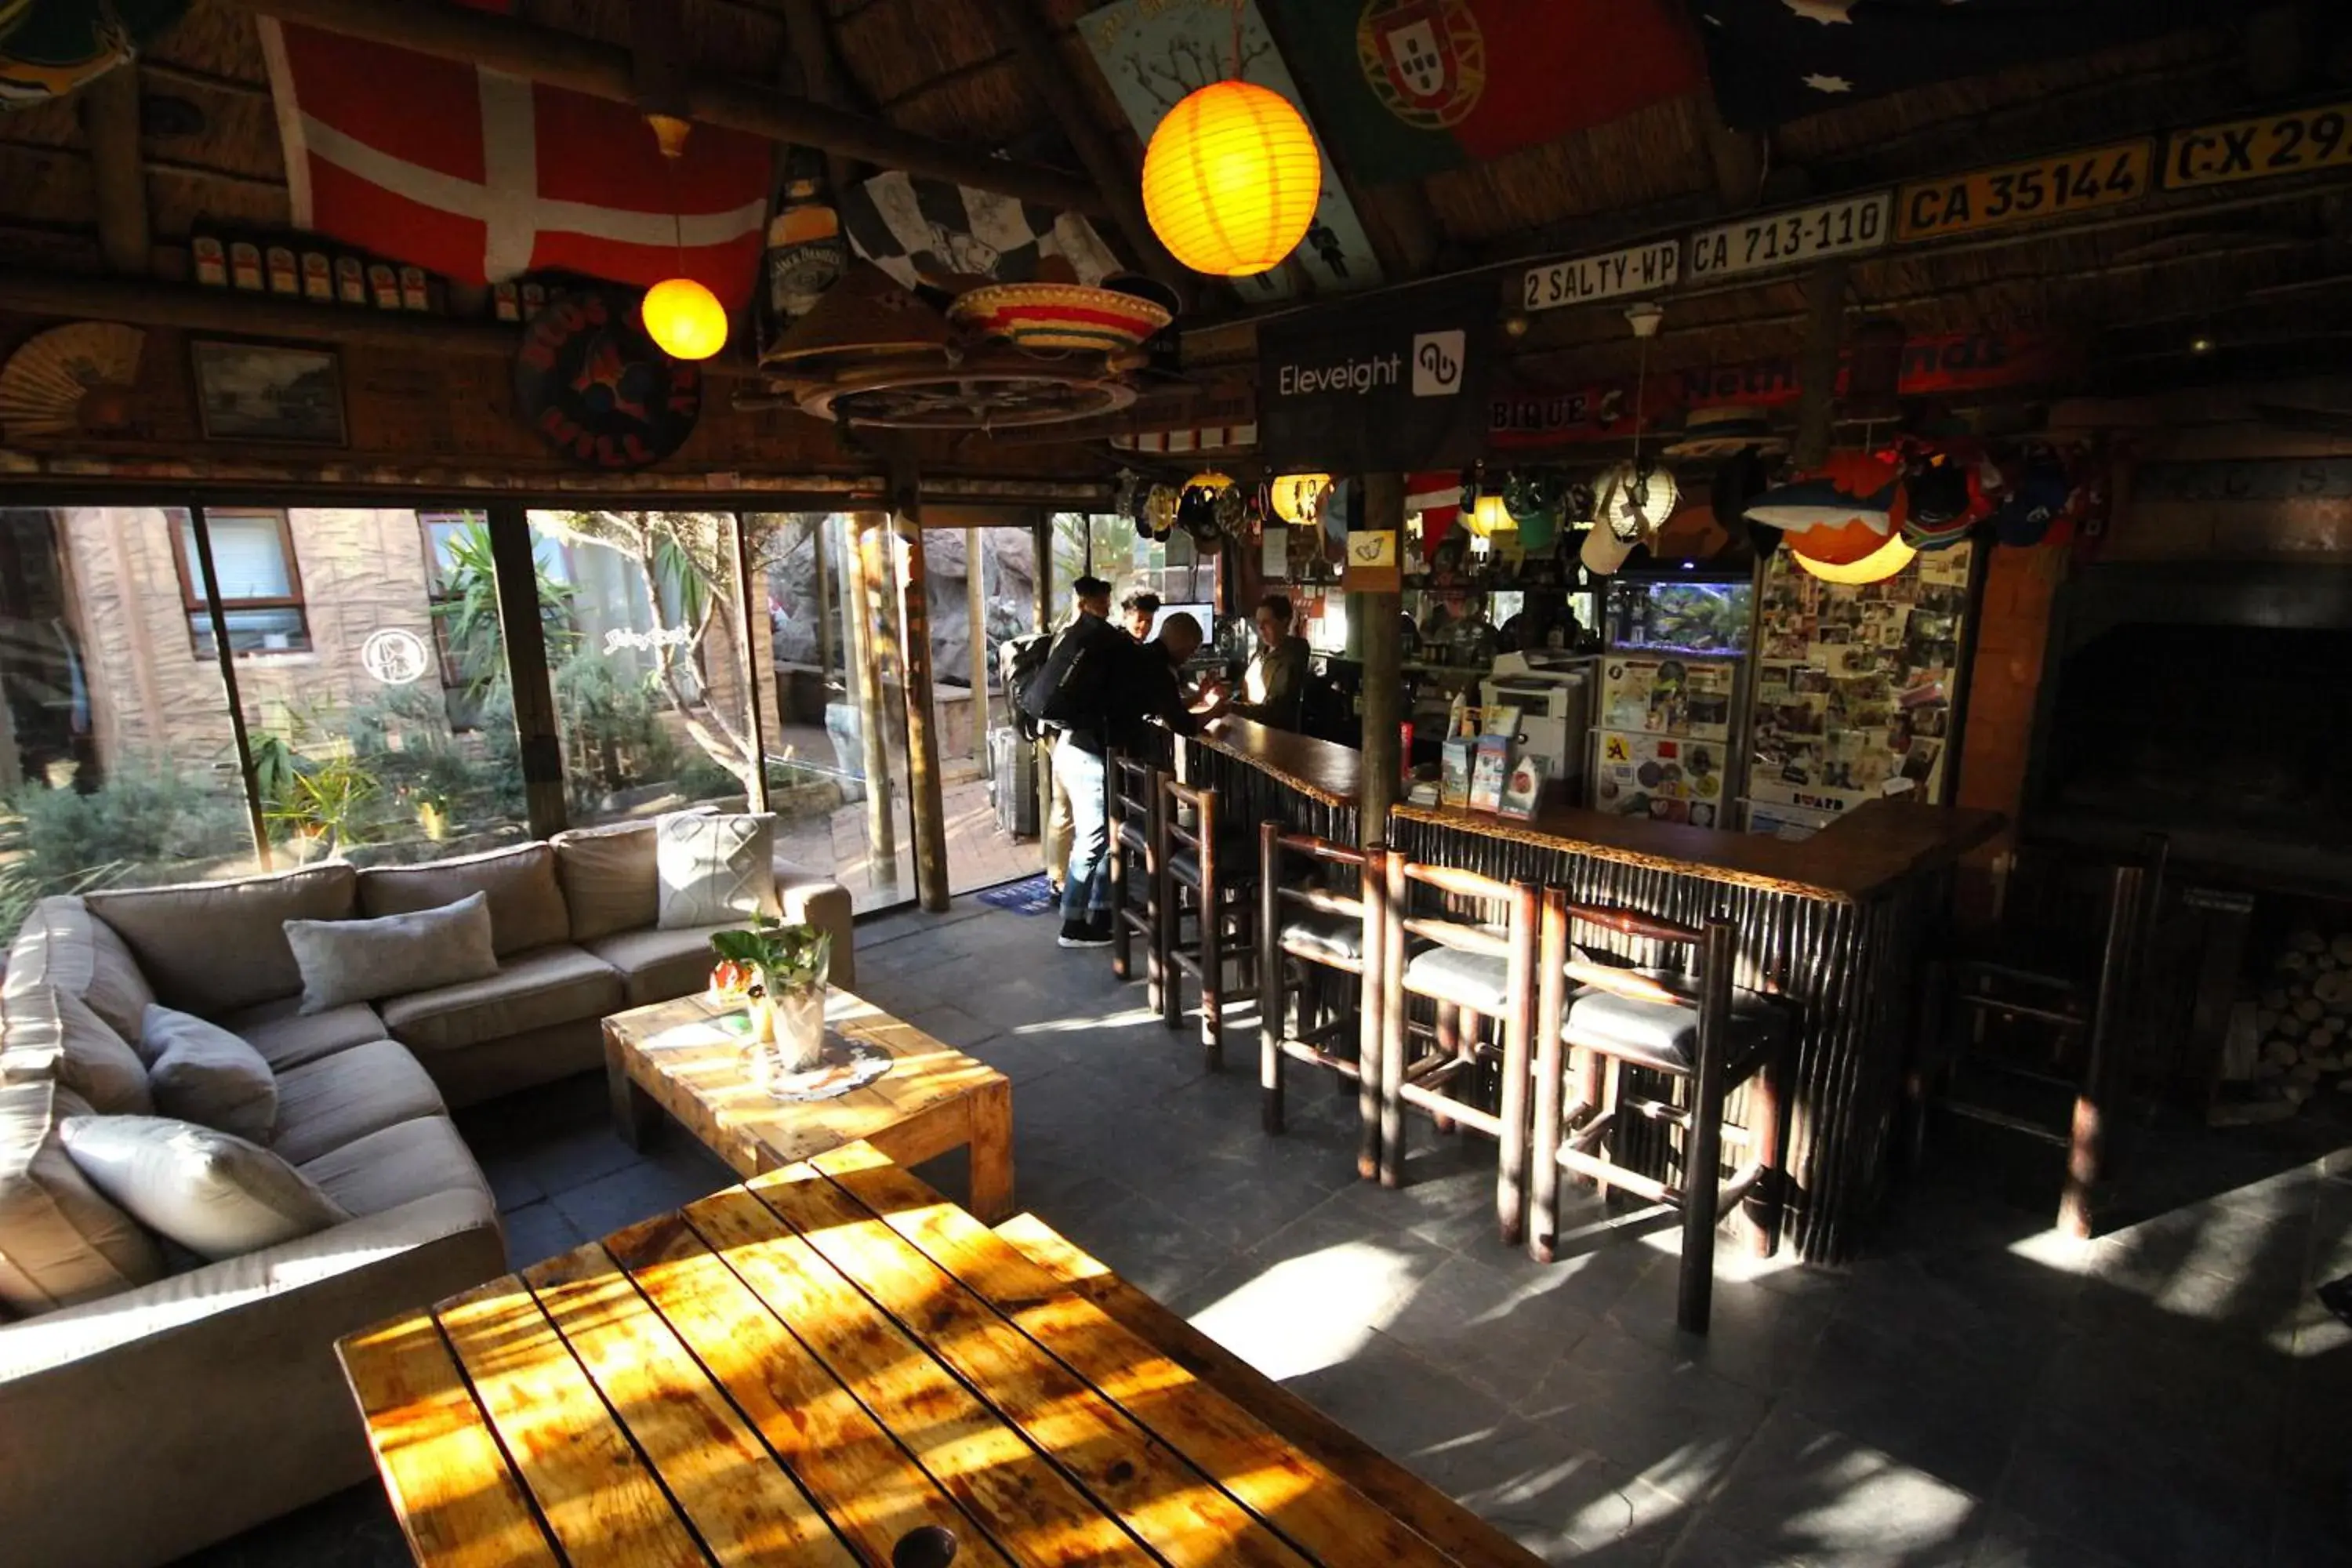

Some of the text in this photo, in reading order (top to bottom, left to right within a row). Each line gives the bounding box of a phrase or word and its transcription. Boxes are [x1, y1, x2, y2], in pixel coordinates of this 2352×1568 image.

[2179, 111, 2352, 180] CX 29
[1911, 152, 2135, 228] CA 35144
[1694, 202, 1879, 271] CA 713-110
[1527, 246, 1675, 306] 2 SALTY-WP
[1279, 350, 1403, 396] Eleveight
